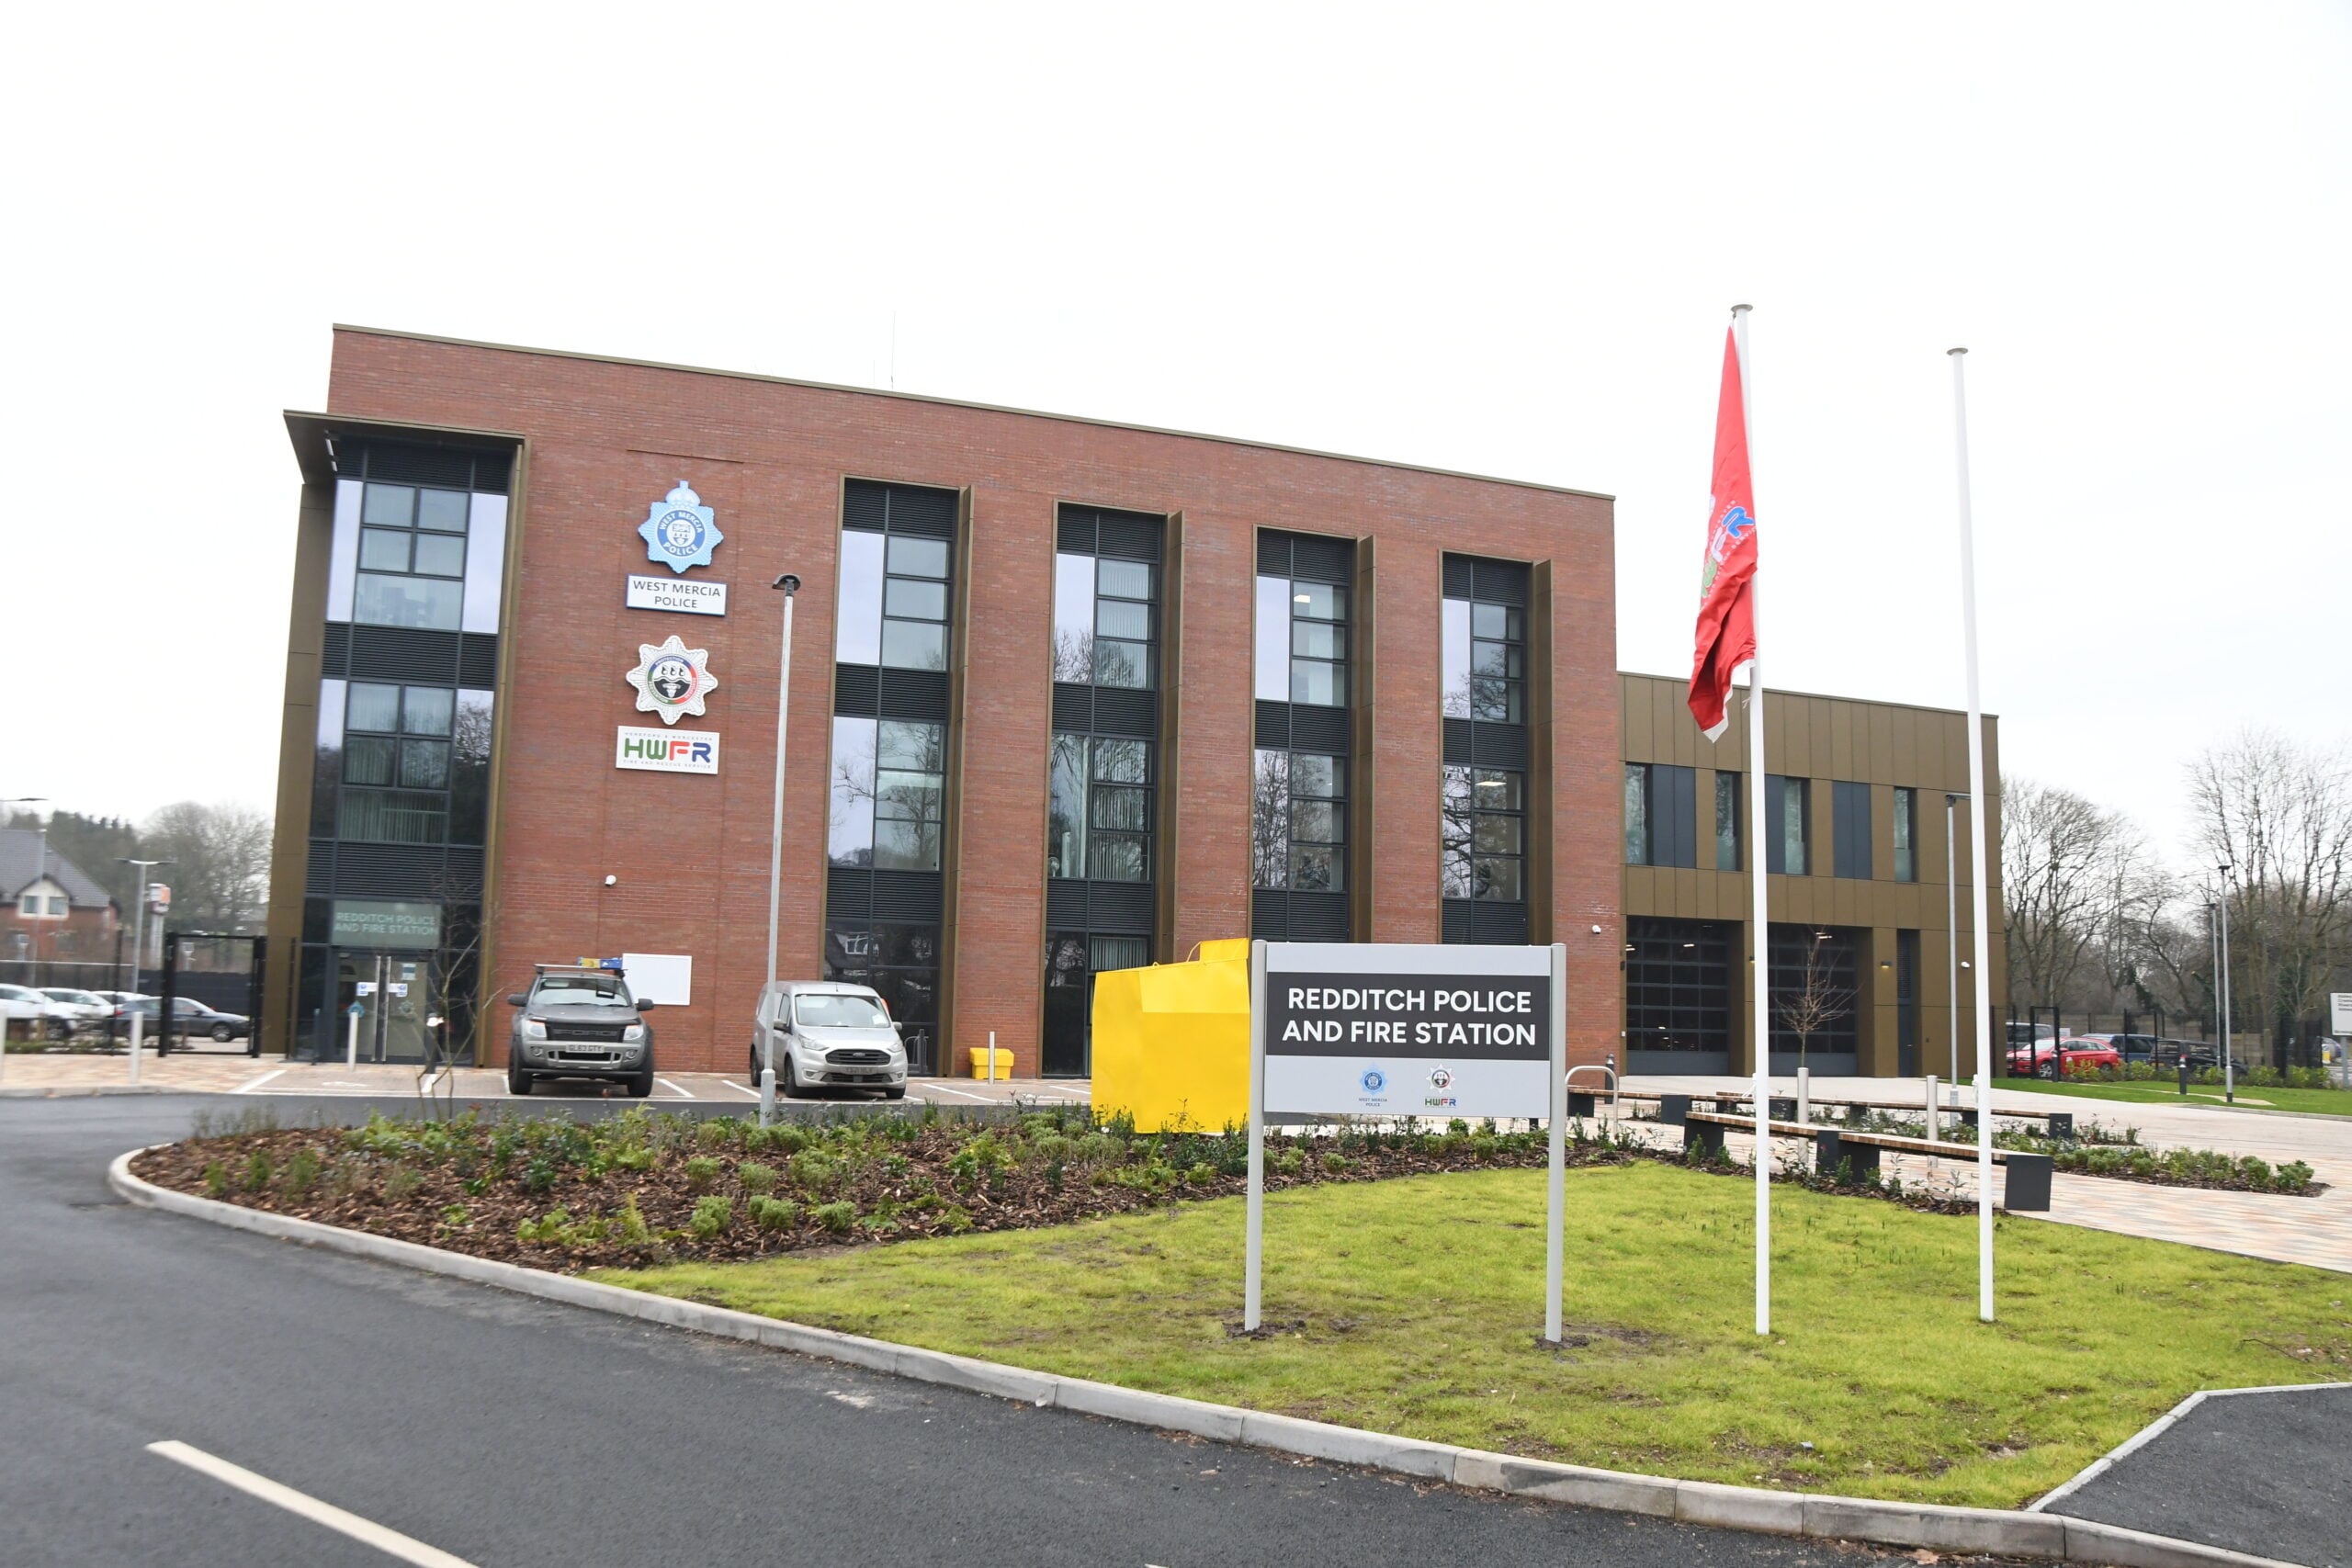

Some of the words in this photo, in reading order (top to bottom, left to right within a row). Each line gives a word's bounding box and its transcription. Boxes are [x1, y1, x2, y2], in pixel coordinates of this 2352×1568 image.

[659, 513, 676, 530] WEST
[678, 511, 705, 533] MERCIA
[662, 542, 699, 555] POLICE
[633, 581, 668, 592] WEST
[672, 583, 721, 597] MERCIA
[654, 596, 698, 608] POLICE
[624, 738, 712, 763] HWFR
[336, 912, 394, 923] REDDITCH
[396, 914, 435, 925] POLICE
[334, 922, 359, 932] AND
[362, 923, 386, 933] FIRE
[1288, 987, 1425, 1011] REDDITCH
[1433, 989, 1532, 1013] POLICE
[1282, 1020, 1343, 1043] AND
[1351, 1021, 1408, 1043] FIRE
[1415, 1021, 1536, 1045] STATION
[1424, 1098, 1457, 1106] HWFR
